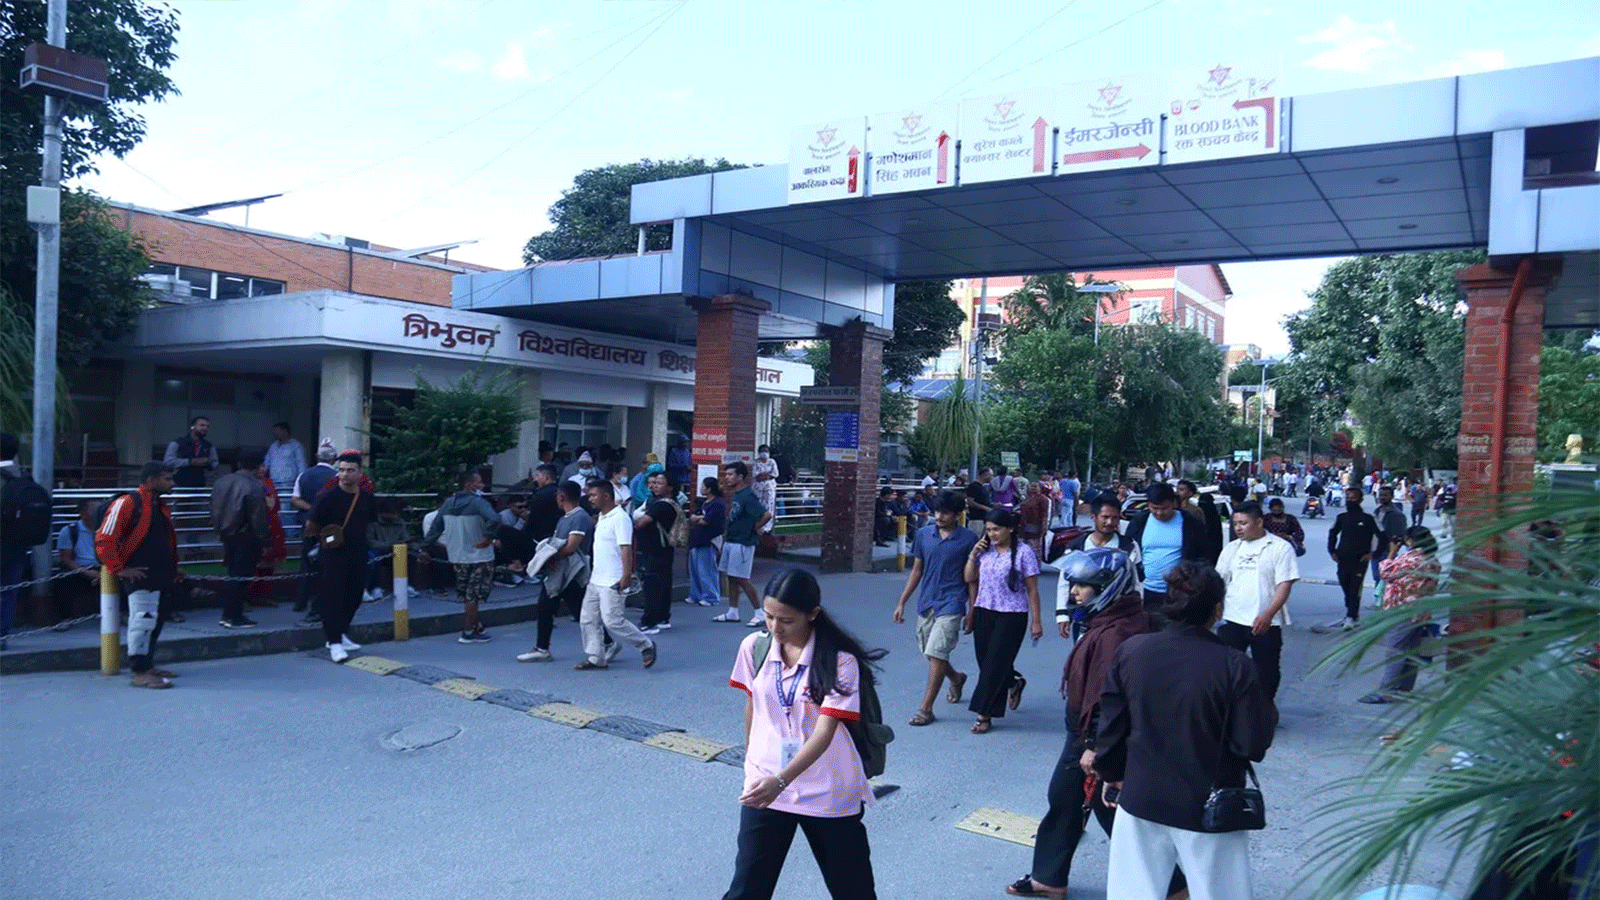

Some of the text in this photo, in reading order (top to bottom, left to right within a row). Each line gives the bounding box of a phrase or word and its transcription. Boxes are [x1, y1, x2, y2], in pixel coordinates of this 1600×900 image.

[1065, 117, 1154, 147] ईमरजेन्सी
[1175, 115, 1259, 136] BLOOD BANK
[876, 150, 933, 166] गणेशमान
[876, 166, 932, 183] सिंह भवन
[402, 313, 501, 348] त्रिभुवन
[517, 330, 648, 367] विश्वविद्यालय
